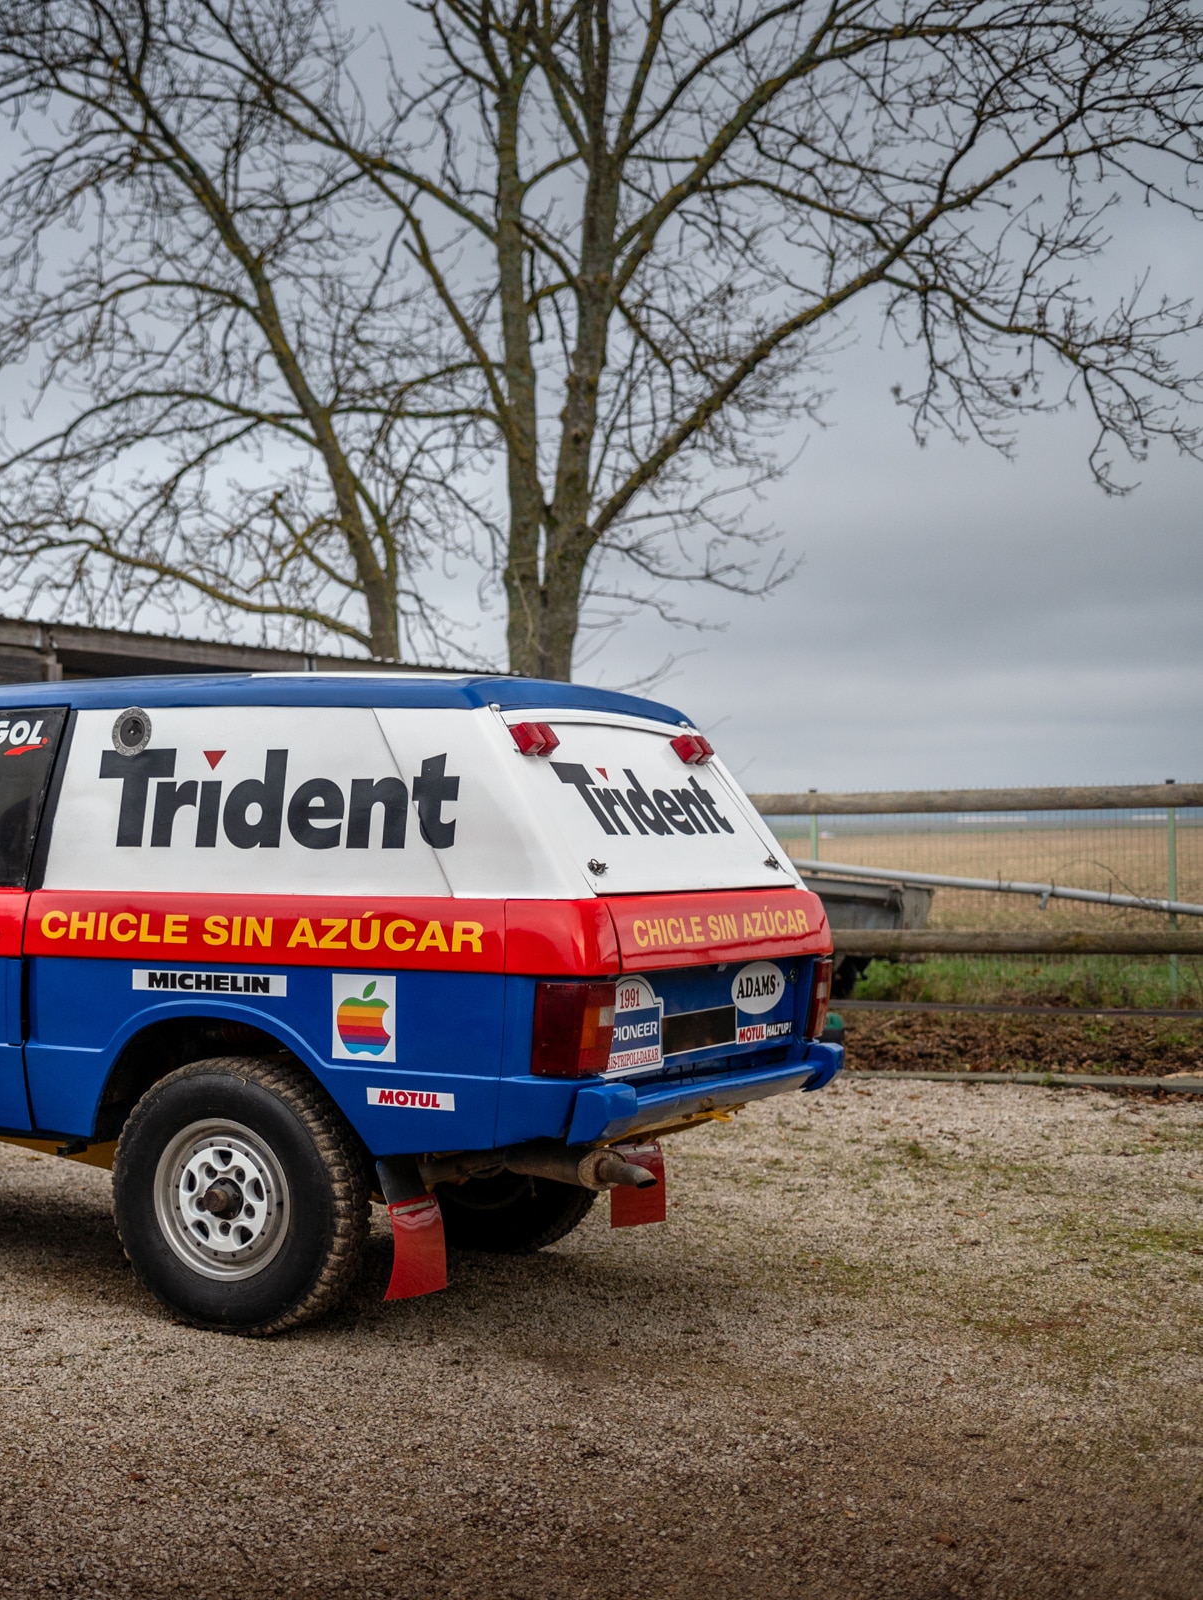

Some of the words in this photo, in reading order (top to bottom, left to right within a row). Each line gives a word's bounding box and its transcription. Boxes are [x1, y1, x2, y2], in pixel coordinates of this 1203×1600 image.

[99, 748, 460, 850] Trident
[549, 761, 735, 836] Trident
[41, 910, 189, 944] CHICLE
[203, 915, 273, 947] SIN
[287, 911, 484, 953] AZÚCAR
[633, 916, 705, 947] CHICLE
[707, 914, 738, 941] SIN
[743, 905, 809, 938] AZÚCAR
[148, 972, 270, 994] MICHELIN
[736, 974, 776, 999] ADAMS
[619, 988, 640, 1009] 1991
[612, 1021, 659, 1042] PIONEER
[739, 1024, 765, 1043] MOTUL
[378, 1090, 440, 1108] MOTUL
